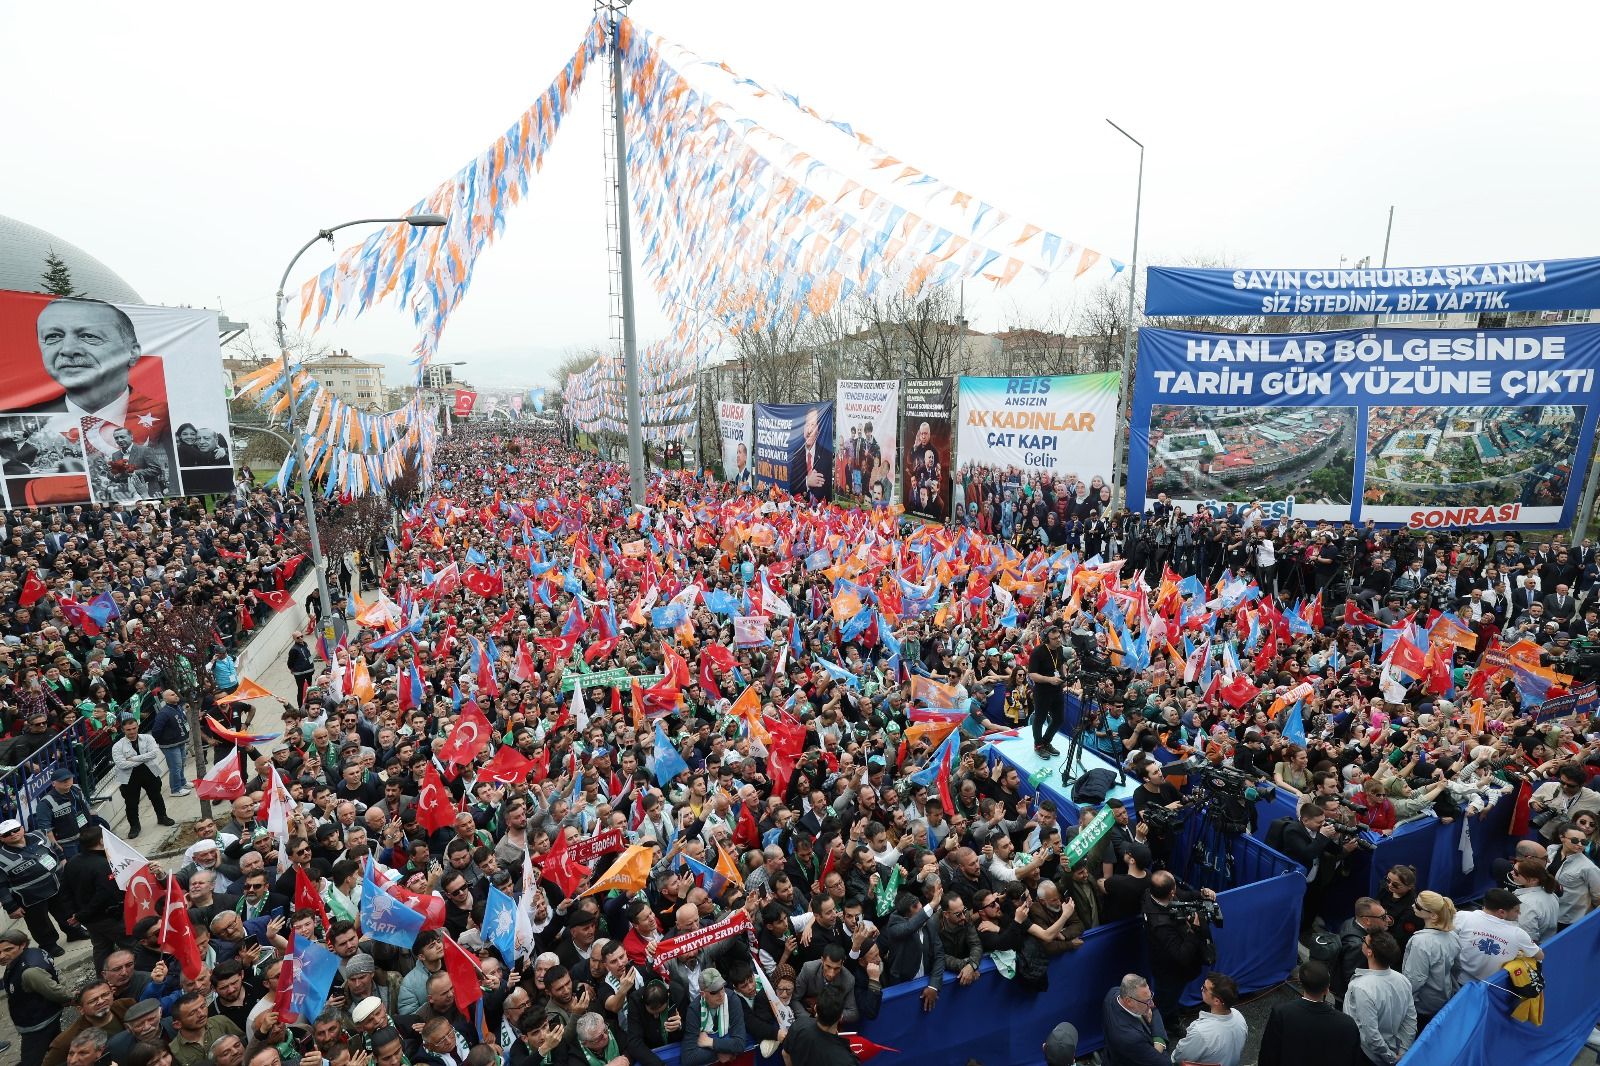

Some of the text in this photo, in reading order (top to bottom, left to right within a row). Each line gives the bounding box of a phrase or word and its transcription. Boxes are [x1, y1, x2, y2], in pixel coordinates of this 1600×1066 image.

[1233, 263, 1547, 290] SAYIN CUMHURBAŞKANIM
[1261, 289, 1510, 314] SİZ İSTEDİNİZ, BİZ YAPTIK.
[1186, 332, 1566, 363] HANLAR BÖLGESİNDE
[1005, 378, 1052, 395] REİS
[1153, 366, 1595, 399] TARİH GÜN YÜZÜNE ÇIKTI
[721, 403, 744, 420] BURSA
[1004, 397, 1048, 407] ANSIZIN
[966, 409, 1096, 432] AK KADINLAR
[721, 426, 744, 442] GELİYOR
[986, 432, 1058, 451] ÇAT KAPI
[1024, 451, 1058, 468] Gelir
[1407, 503, 1522, 530] SONRASI
[1074, 821, 1108, 857] BURSA
[680, 935, 714, 955] TAYYİP
